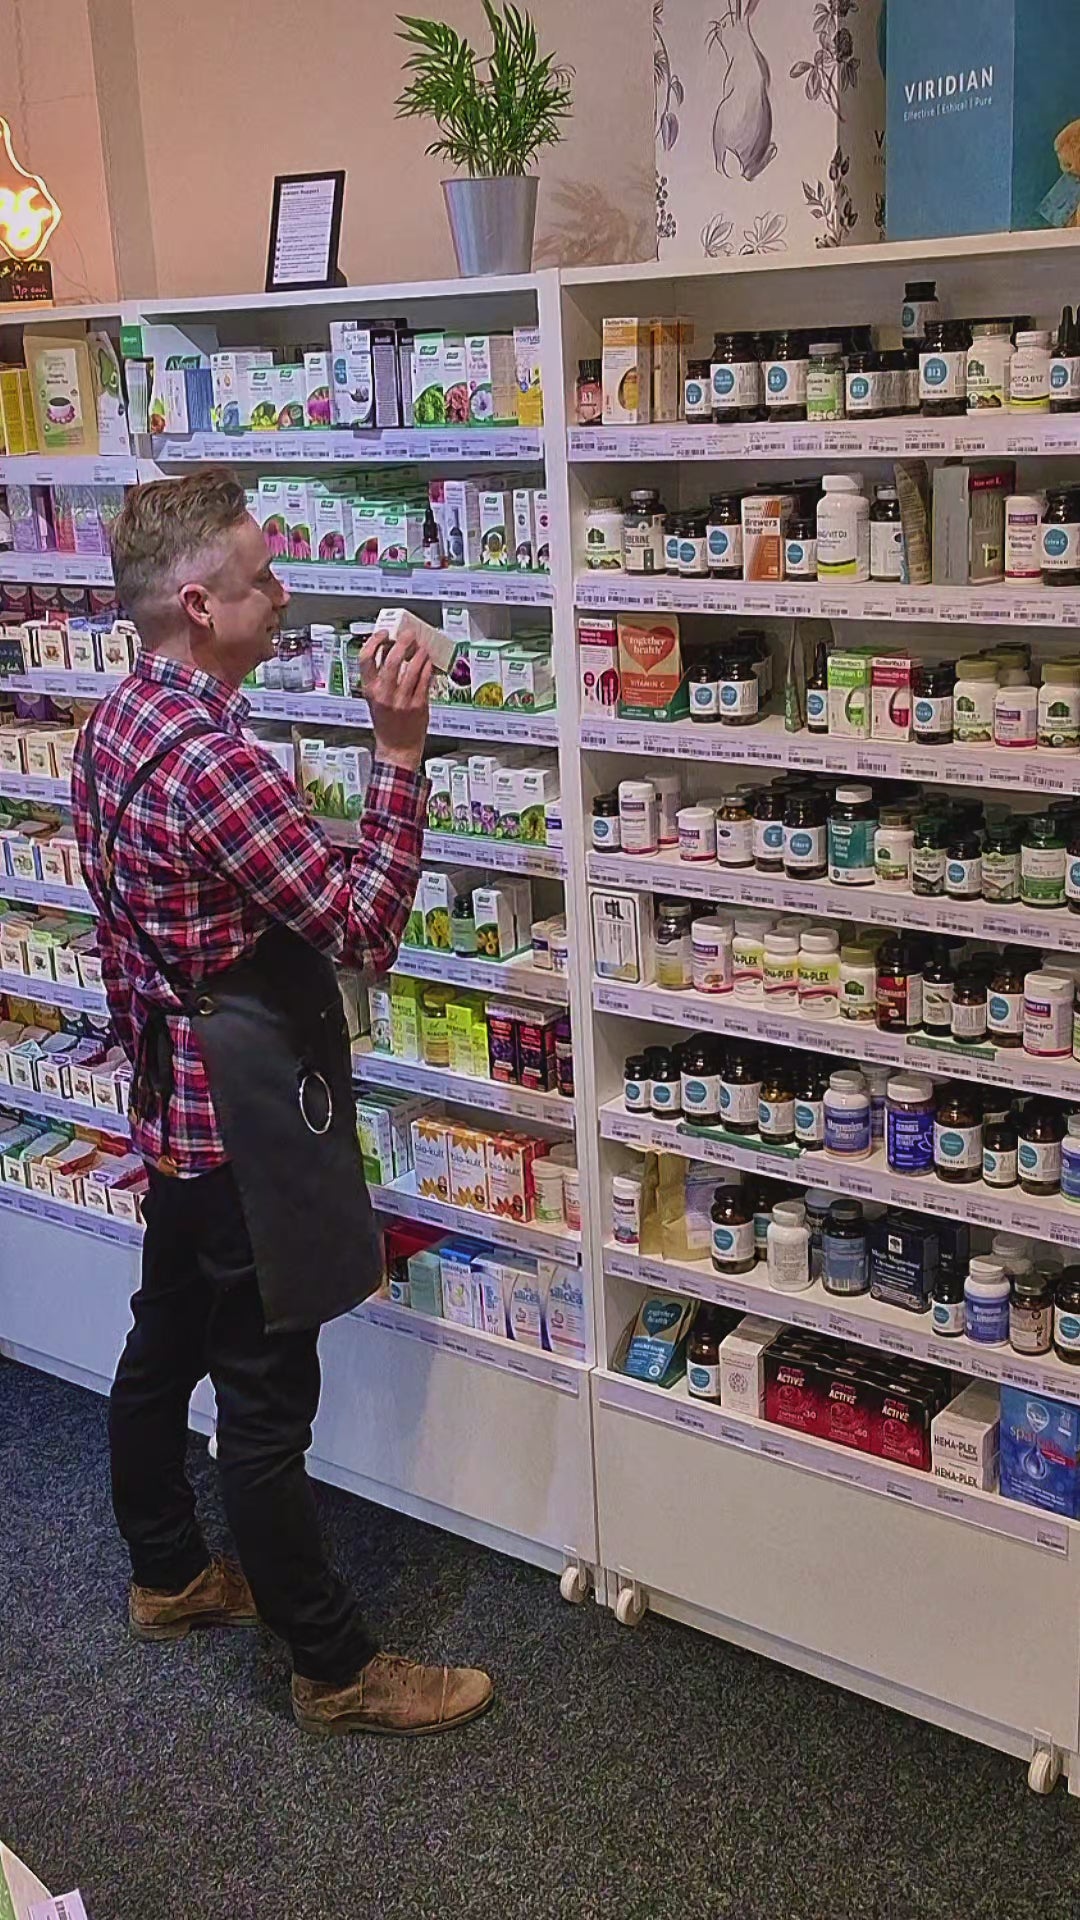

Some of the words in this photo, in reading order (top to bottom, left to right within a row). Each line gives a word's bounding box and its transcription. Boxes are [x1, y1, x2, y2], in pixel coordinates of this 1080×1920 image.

[904, 65, 993, 105] VIRIDIAN
[903, 108, 935, 121] Effective
[942, 103, 967, 115] Ethical
[975, 96, 992, 108] Pure
[926, 366, 941, 377] B12
[744, 519, 778, 527] Brewers
[629, 635, 666, 647] together
[633, 644, 662, 655] health
[630, 680, 658, 688] VITAMIN
[415, 1142, 444, 1159] bio-kult
[451, 1152, 482, 1168] bio-kult
[489, 1162, 520, 1177] bio-kult
[777, 1372, 805, 1387] ACTIVE
[828, 1389, 857, 1405] ACTIVE
[882, 1405, 910, 1422] ACTIVE
[934, 1434, 977, 1455] HEMA-PLEX
[934, 1466, 978, 1488] HEMA-PLEX
